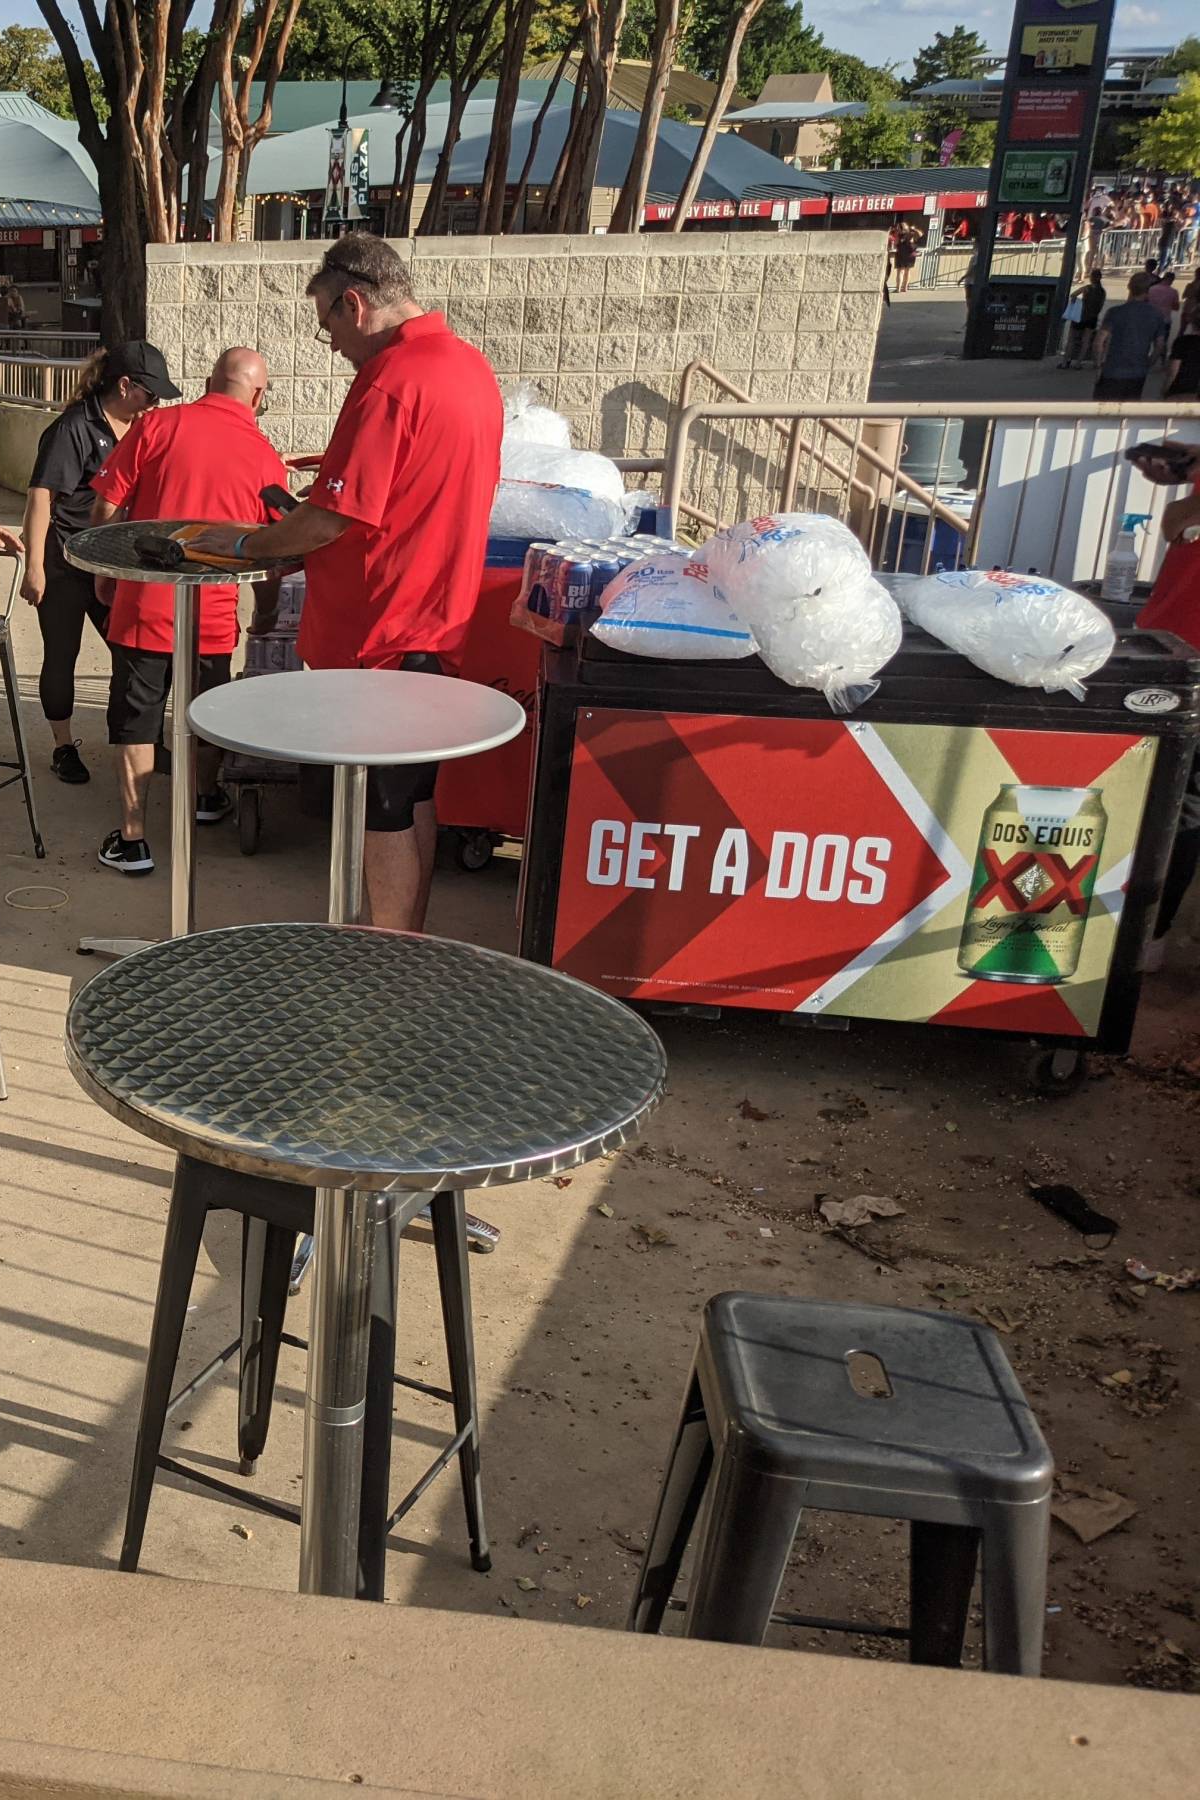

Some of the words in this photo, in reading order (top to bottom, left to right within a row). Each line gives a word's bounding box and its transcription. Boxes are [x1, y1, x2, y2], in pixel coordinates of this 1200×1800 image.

[358, 141, 368, 205] PLAZA
[686, 206, 699, 217] BY
[703, 205, 720, 216] THE
[723, 204, 760, 217] BOTLE
[832, 199, 863, 212] CRAFT
[866, 198, 894, 210] BEER
[626, 567, 655, 582] 20
[992, 823, 1029, 844] DOS
[1034, 826, 1095, 847] EQUIS
[586, 819, 700, 891] GET
[709, 828, 749, 896] A
[765, 831, 892, 905] DOS
[976, 849, 1099, 915] XX
[979, 915, 1017, 935] Lager
[1017, 917, 1071, 932] Especial
